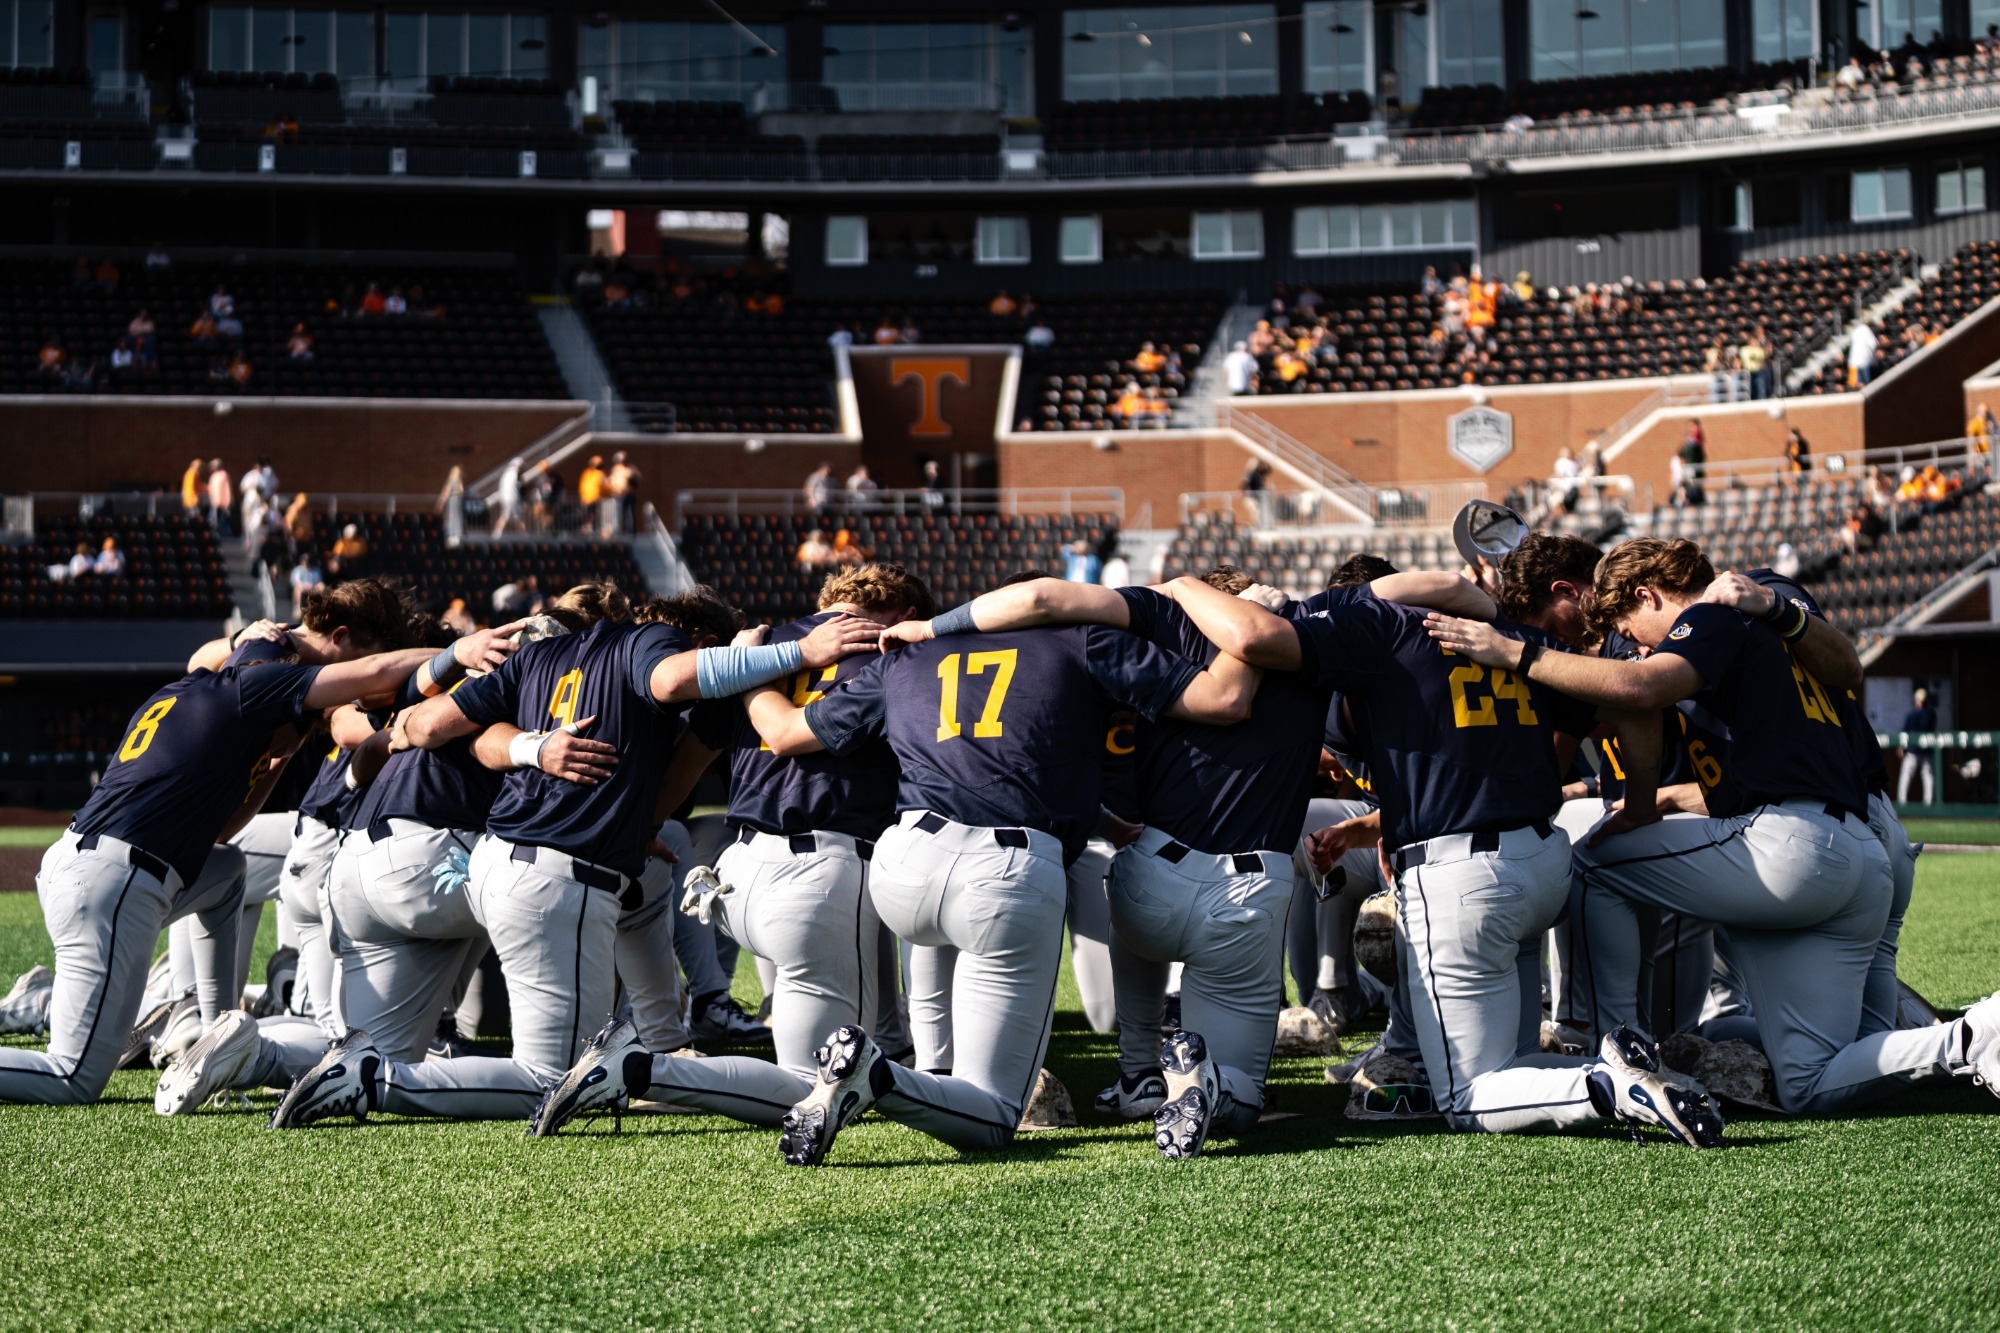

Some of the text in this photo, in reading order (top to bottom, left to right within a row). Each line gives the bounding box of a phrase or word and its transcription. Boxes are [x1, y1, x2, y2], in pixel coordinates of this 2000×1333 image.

[892, 358, 970, 437] T
[542, 666, 584, 736] 9
[937, 648, 1018, 743] 17
[1440, 640, 1539, 728] 24
[118, 695, 178, 764] 8
[1147, 1084, 1163, 1094] NIKE
